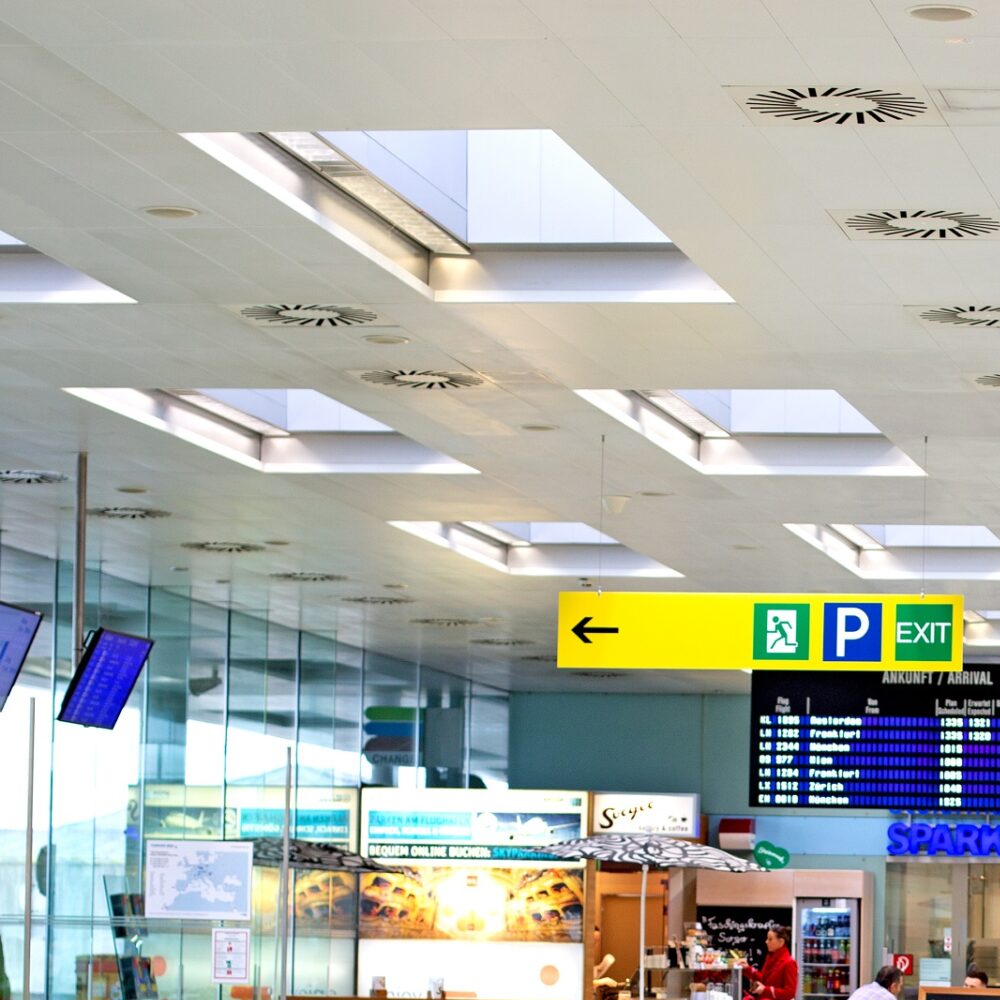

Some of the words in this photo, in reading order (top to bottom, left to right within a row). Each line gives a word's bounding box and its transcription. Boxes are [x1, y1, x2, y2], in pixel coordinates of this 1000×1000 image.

[837, 607, 869, 657] P
[896, 622, 951, 644] EXIT
[882, 671, 932, 685] ANKUNFT
[948, 671, 993, 685] ARRIVAL
[369, 846, 409, 856] BEQUEM
[411, 846, 446, 857] ONLINE
